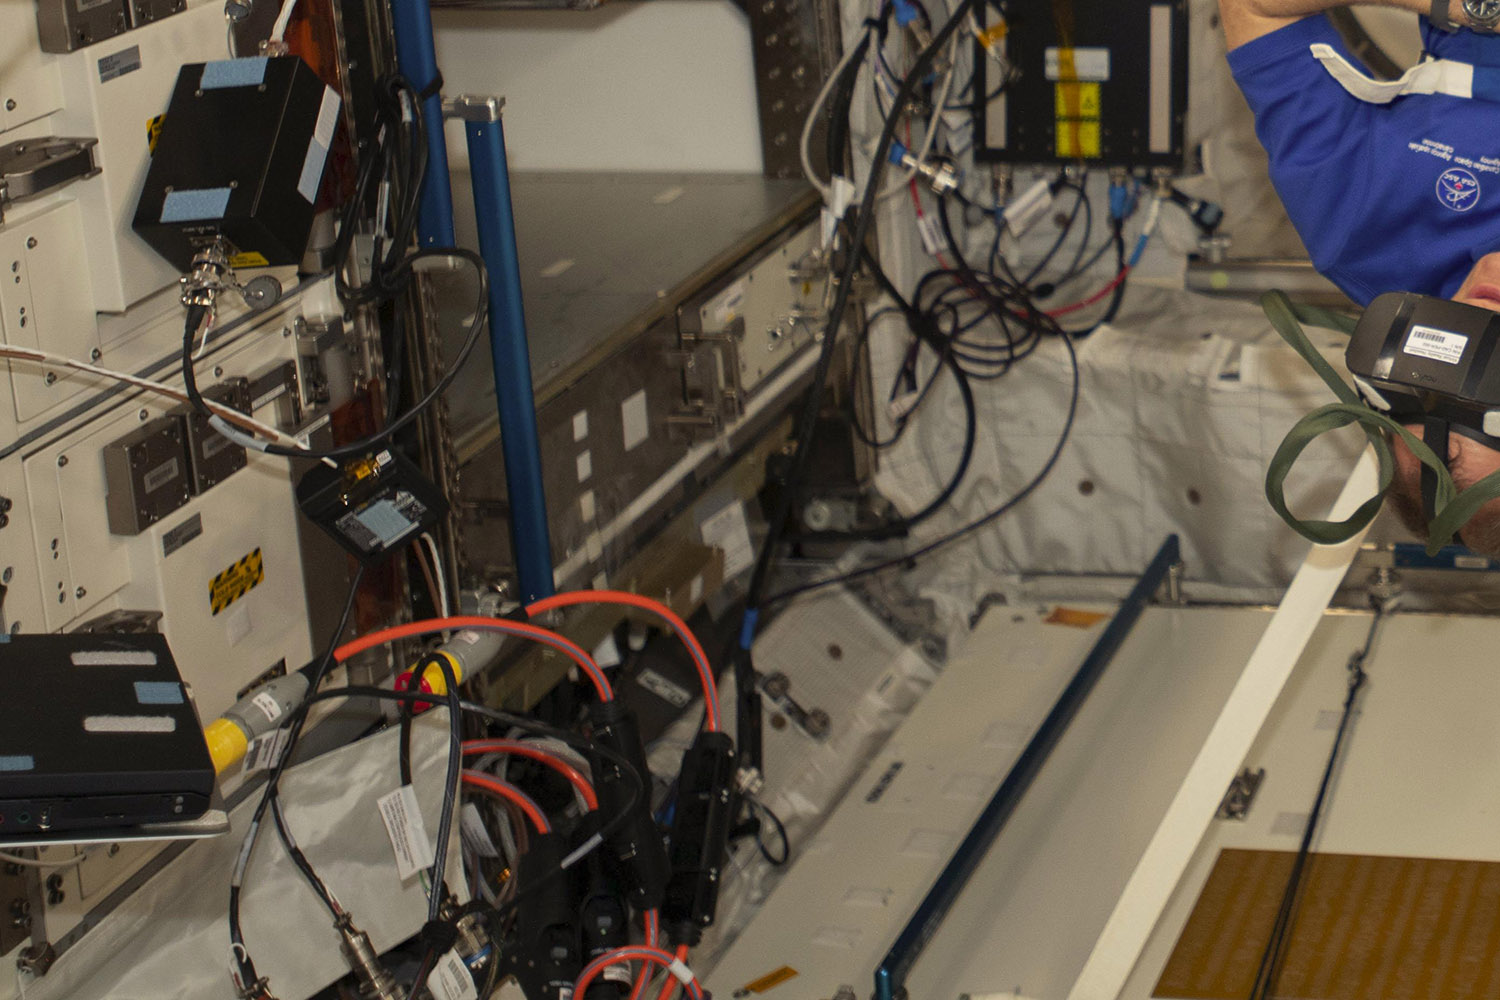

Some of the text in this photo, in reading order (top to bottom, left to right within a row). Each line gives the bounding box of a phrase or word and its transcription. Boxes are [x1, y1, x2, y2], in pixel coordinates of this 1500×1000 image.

[1453, 156, 1500, 174] Canadian Space
[1443, 173, 1476, 187] CSA ASC
